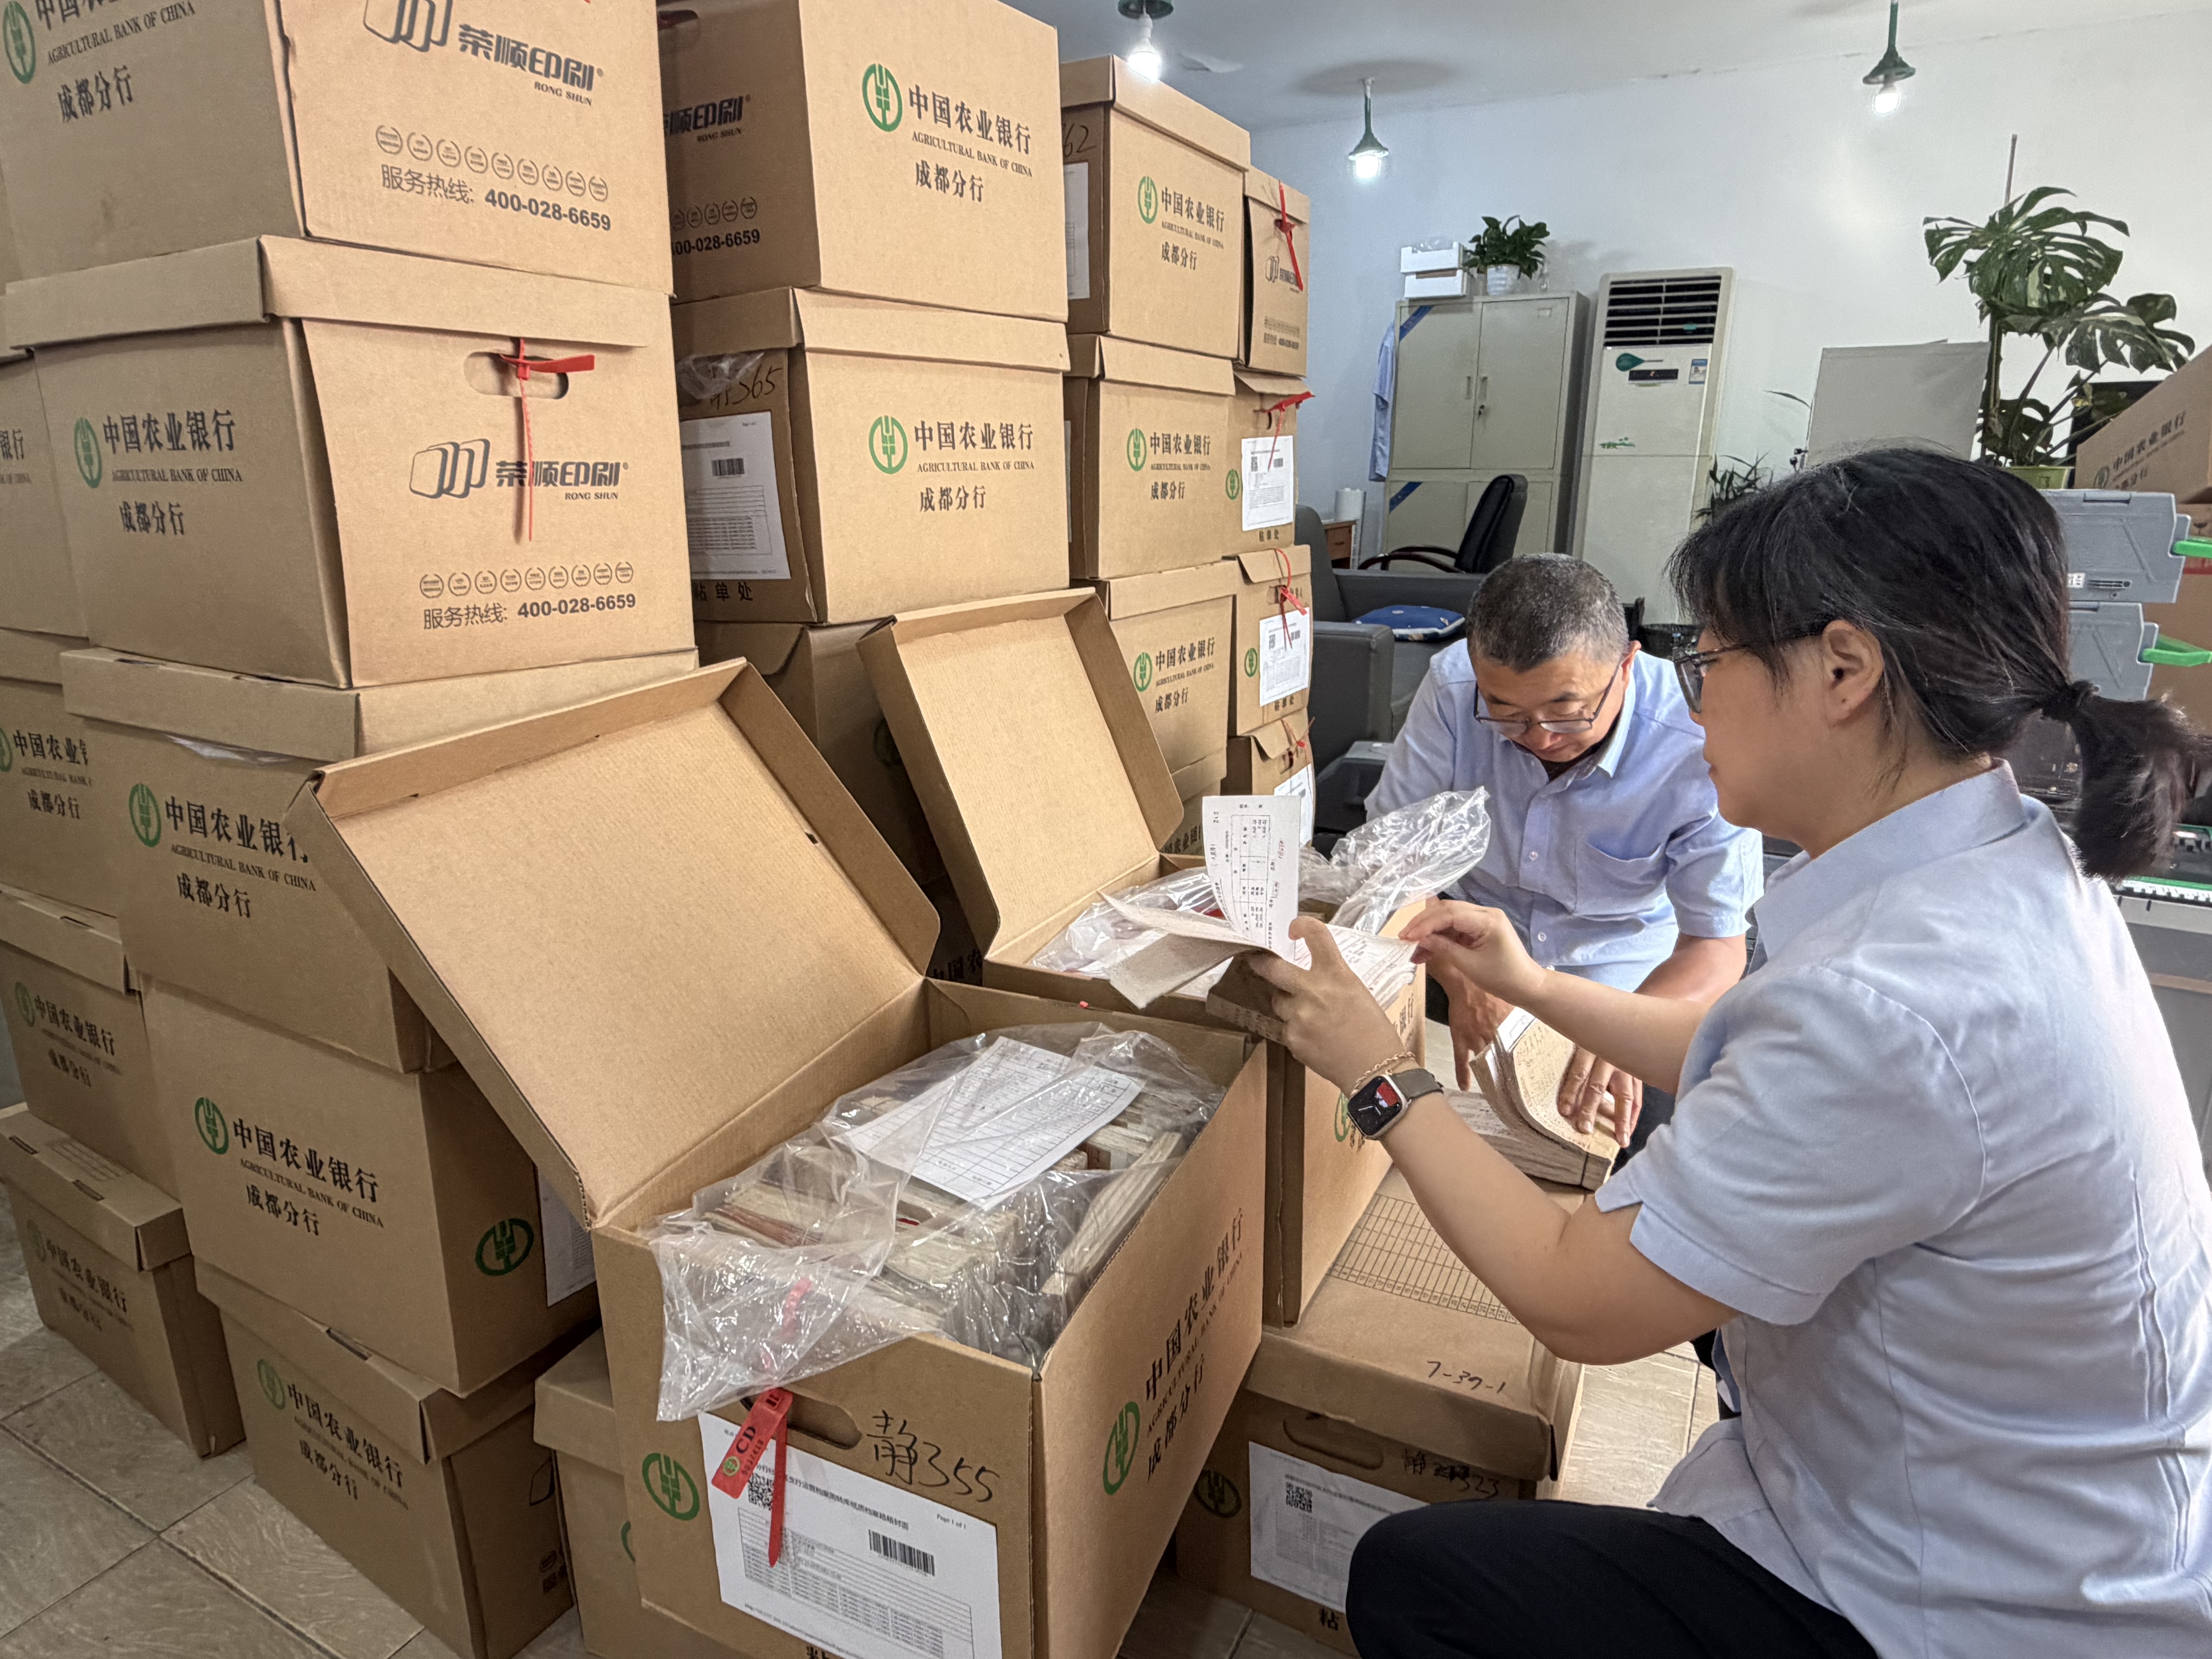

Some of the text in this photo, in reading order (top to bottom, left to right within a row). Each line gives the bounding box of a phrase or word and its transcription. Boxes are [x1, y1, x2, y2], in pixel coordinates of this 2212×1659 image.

[48, 1, 195, 65] AGRICULTURAL BANK OF CHINA
[57, 65, 133, 123] 成都分行
[534, 81, 592, 106] RONG SHUN
[909, 84, 1031, 155] 中国农业银行
[912, 131, 1032, 177] AGRICULTURAL BANK OF CHINA
[915, 159, 984, 202] 成都分行
[484, 189, 611, 232] 400-028-6659
[1161, 186, 1224, 232] 中国农业银行
[1161, 241, 1197, 271] 成都分行
[103, 409, 235, 455] 中国农业银行
[914, 420, 1033, 451] 中国农业银行
[1150, 431, 1211, 456] 中国农业银行
[112, 468, 243, 482] AGRICULTURAL BANK OF CHINA
[917, 460, 1035, 472] AGRICULTURAL BANK OF CHINA
[119, 501, 184, 535] 成都分行
[565, 492, 619, 500] RONG SHUN
[920, 485, 986, 513] 成都分行
[517, 592, 636, 619] 400-028-6659
[1156, 637, 1215, 672] 中国农业银行
[1155, 687, 1188, 714] 成都分行
[171, 843, 317, 891] AGRICULTURAL BANK OF CHINA
[177, 872, 251, 919] 成都分行
[35, 995, 115, 1056] 中国农业银行
[233, 1118, 379, 1203] 中国农业银行
[240, 1158, 385, 1229] AGRICULTURAL BANK OF CHINA
[246, 1184, 319, 1236] 成都分行
[1146, 1207, 1243, 1401] 中国农业银行
[287, 1384, 402, 1489] 中国农业银行
[736, 1426, 756, 1454] CD
[1147, 1353, 1204, 1483] 成都分行
